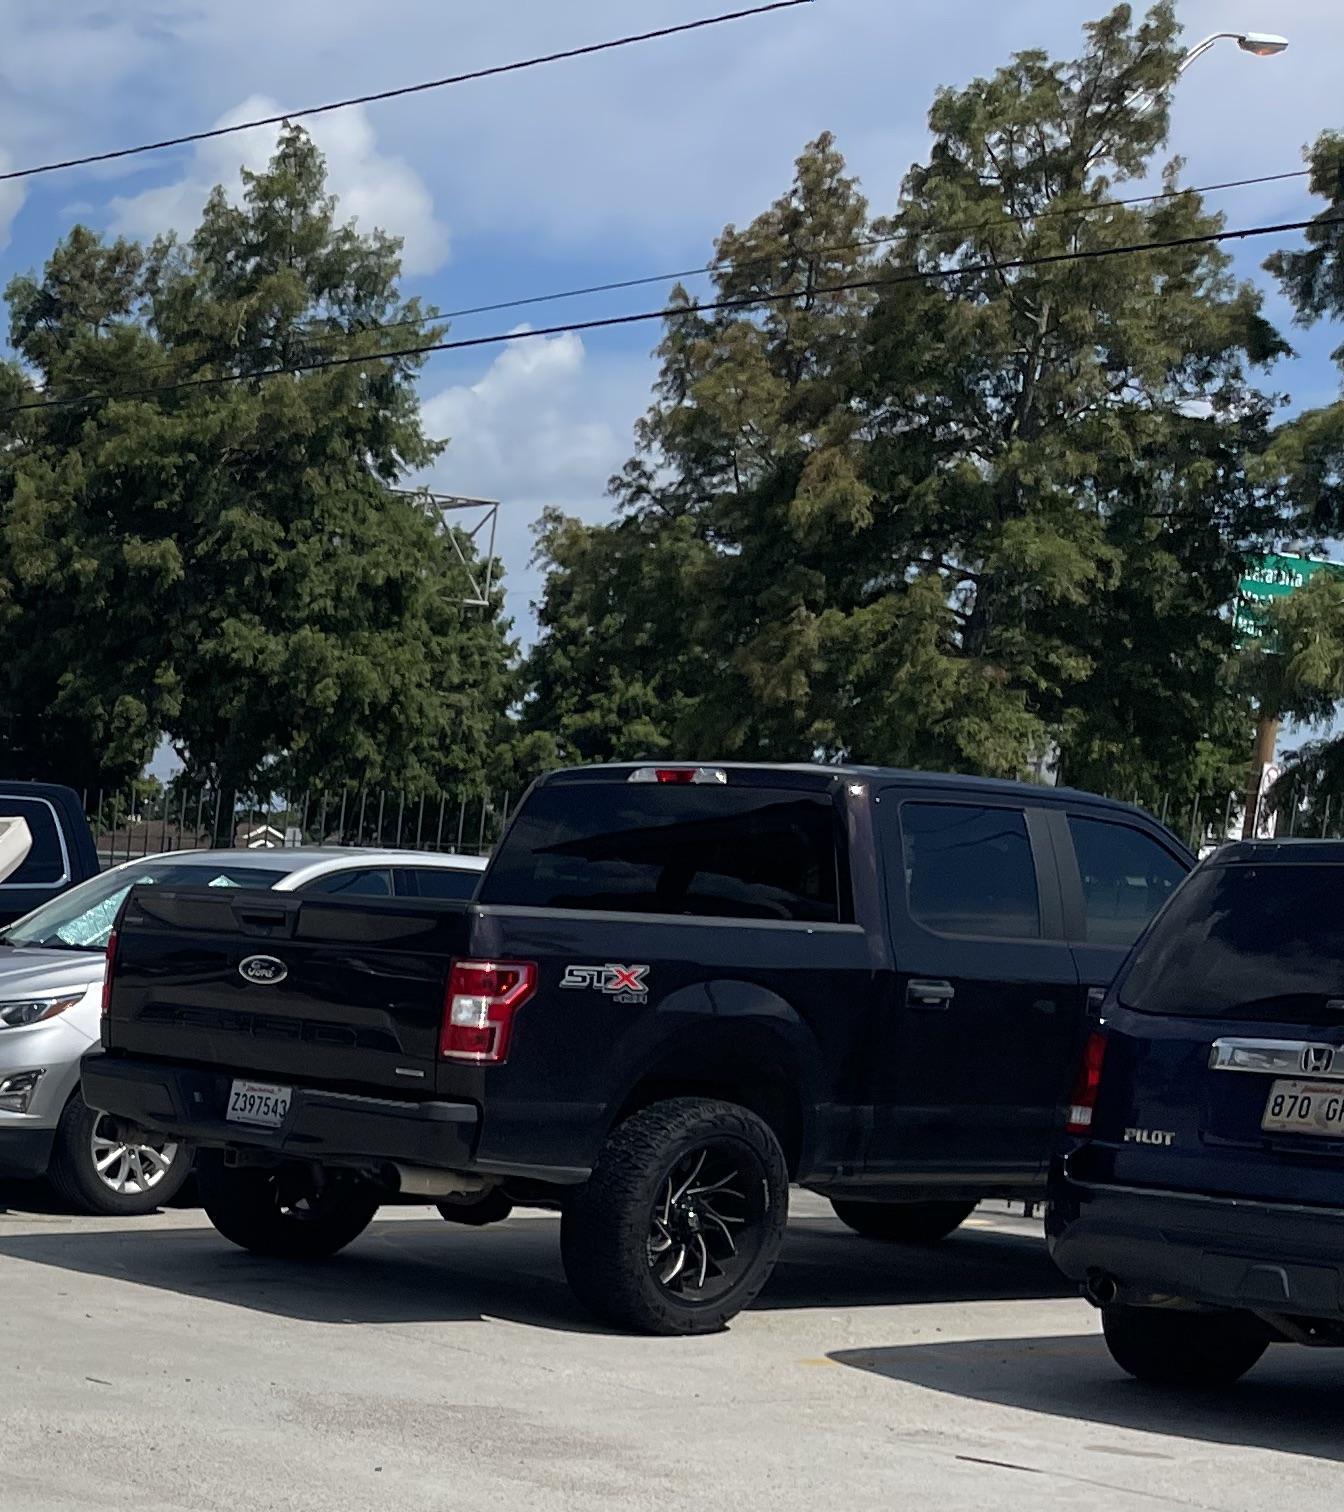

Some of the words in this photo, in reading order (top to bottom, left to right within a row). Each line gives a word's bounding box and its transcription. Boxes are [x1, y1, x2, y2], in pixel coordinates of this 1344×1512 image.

[559, 963, 650, 993] STX
[231, 1092, 287, 1118] Z397543
[1271, 1094, 1312, 1119] 870
[1325, 1098, 1344, 1122] G
[1124, 1128, 1175, 1145] PILOT
